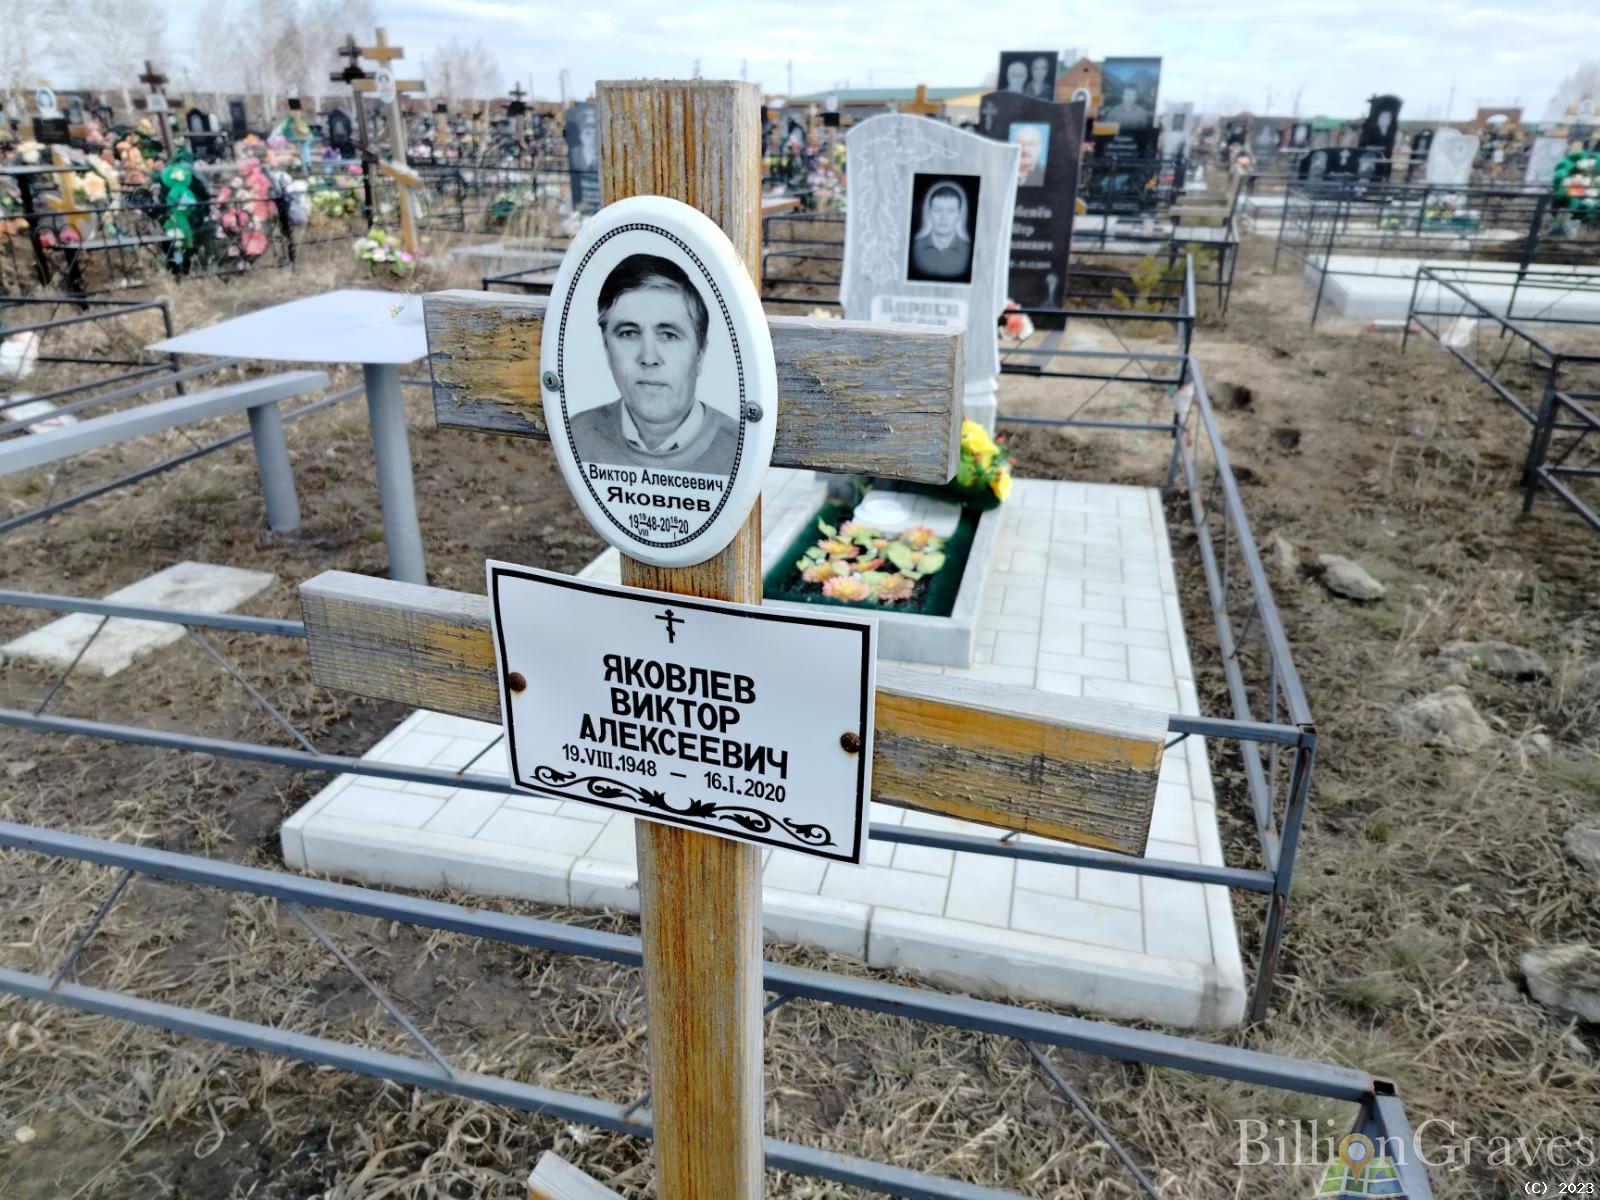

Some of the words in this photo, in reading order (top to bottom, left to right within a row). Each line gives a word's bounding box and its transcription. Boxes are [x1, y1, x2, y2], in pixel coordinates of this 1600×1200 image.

[589, 463, 638, 487] Виктор
[641, 468, 723, 492] Алексеевич
[607, 486, 711, 513] Яковлев
[603, 653, 756, 705] ЯКОВЛЕВ
[610, 687, 741, 734] ВИКТОР
[579, 713, 789, 780] АЛЕКСЕЕВИЧ
[561, 742, 658, 778] 19.VIII.1948
[703, 770, 787, 803] 16.I.2020
